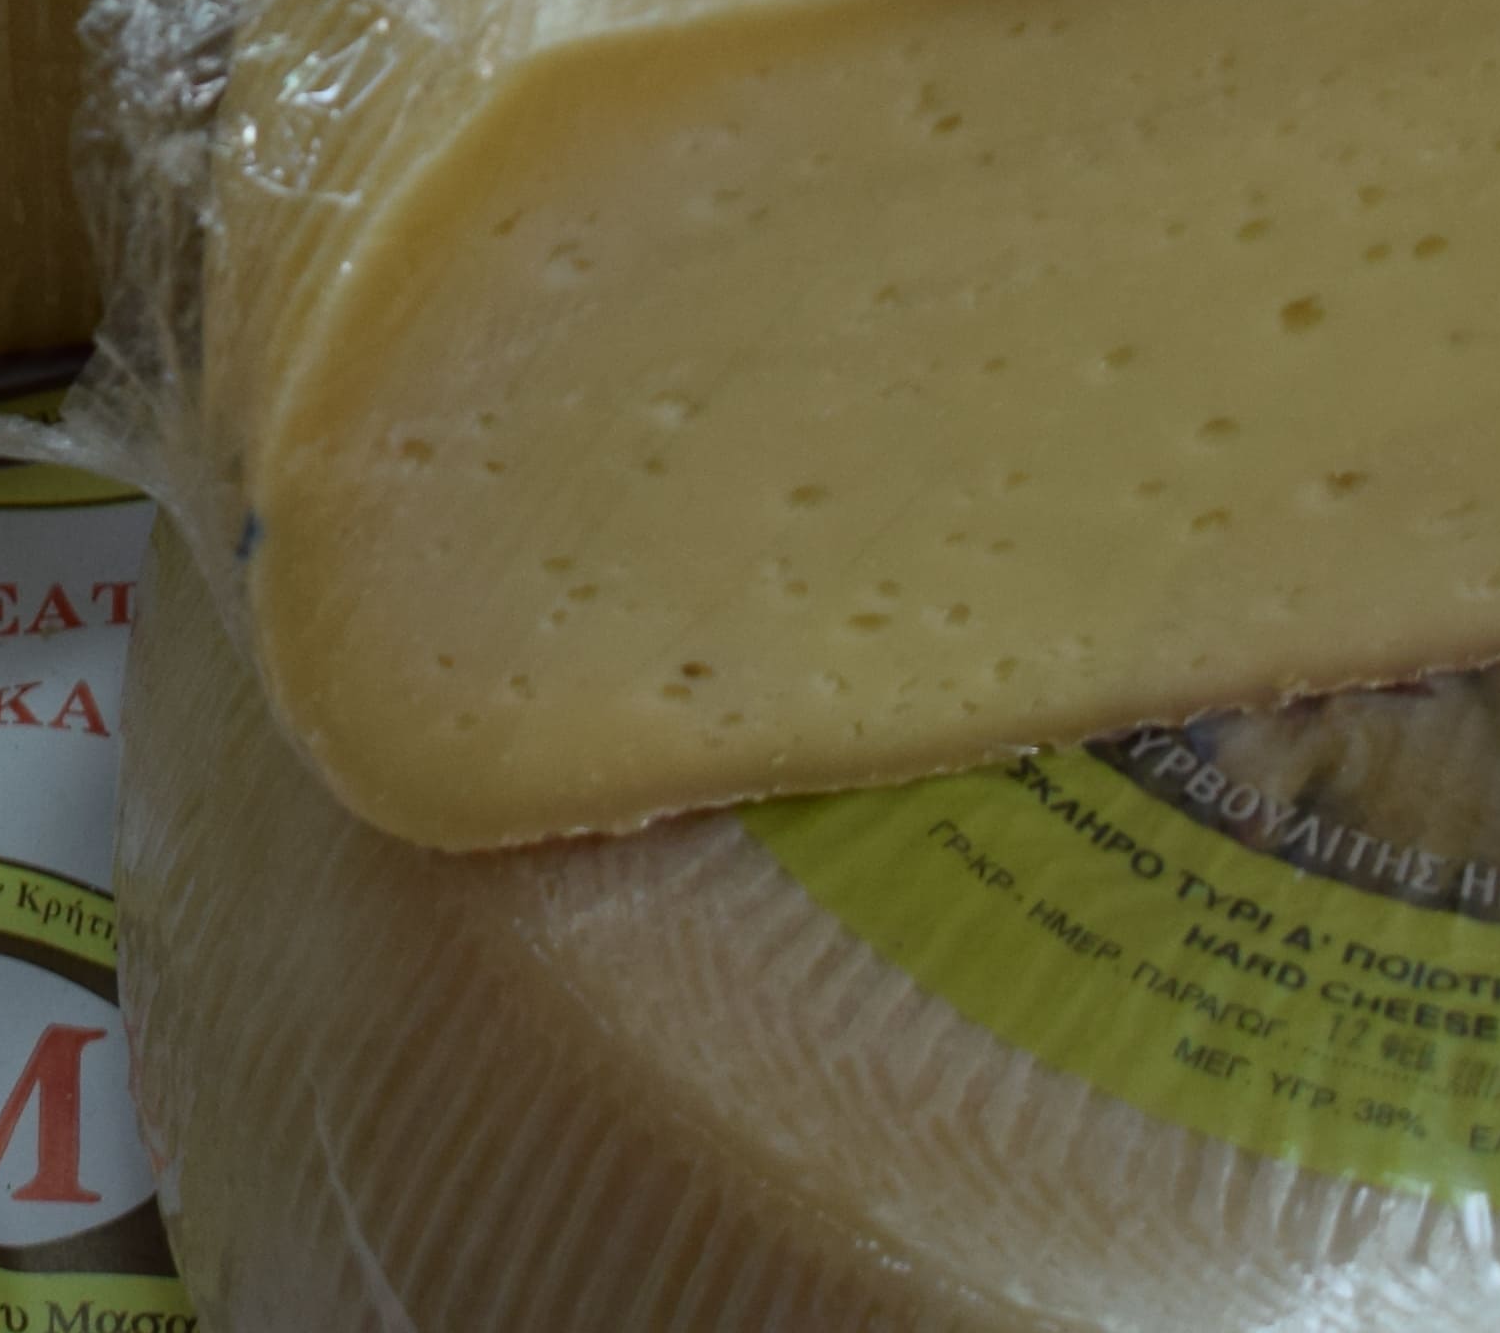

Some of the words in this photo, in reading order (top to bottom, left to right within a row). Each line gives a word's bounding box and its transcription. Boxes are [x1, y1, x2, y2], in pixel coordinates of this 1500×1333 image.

[1005, 756, 1165, 881] ΣΚΛΗΡΟ
[1176, 870, 1274, 933] ΤΥΡΙ
[1027, 898, 1123, 969] ΗΜΕΡ.
[1184, 925, 1308, 991] HARD
[1321, 980, 1499, 1039] CHEESE
[1354, 1095, 1429, 1139] 38%
